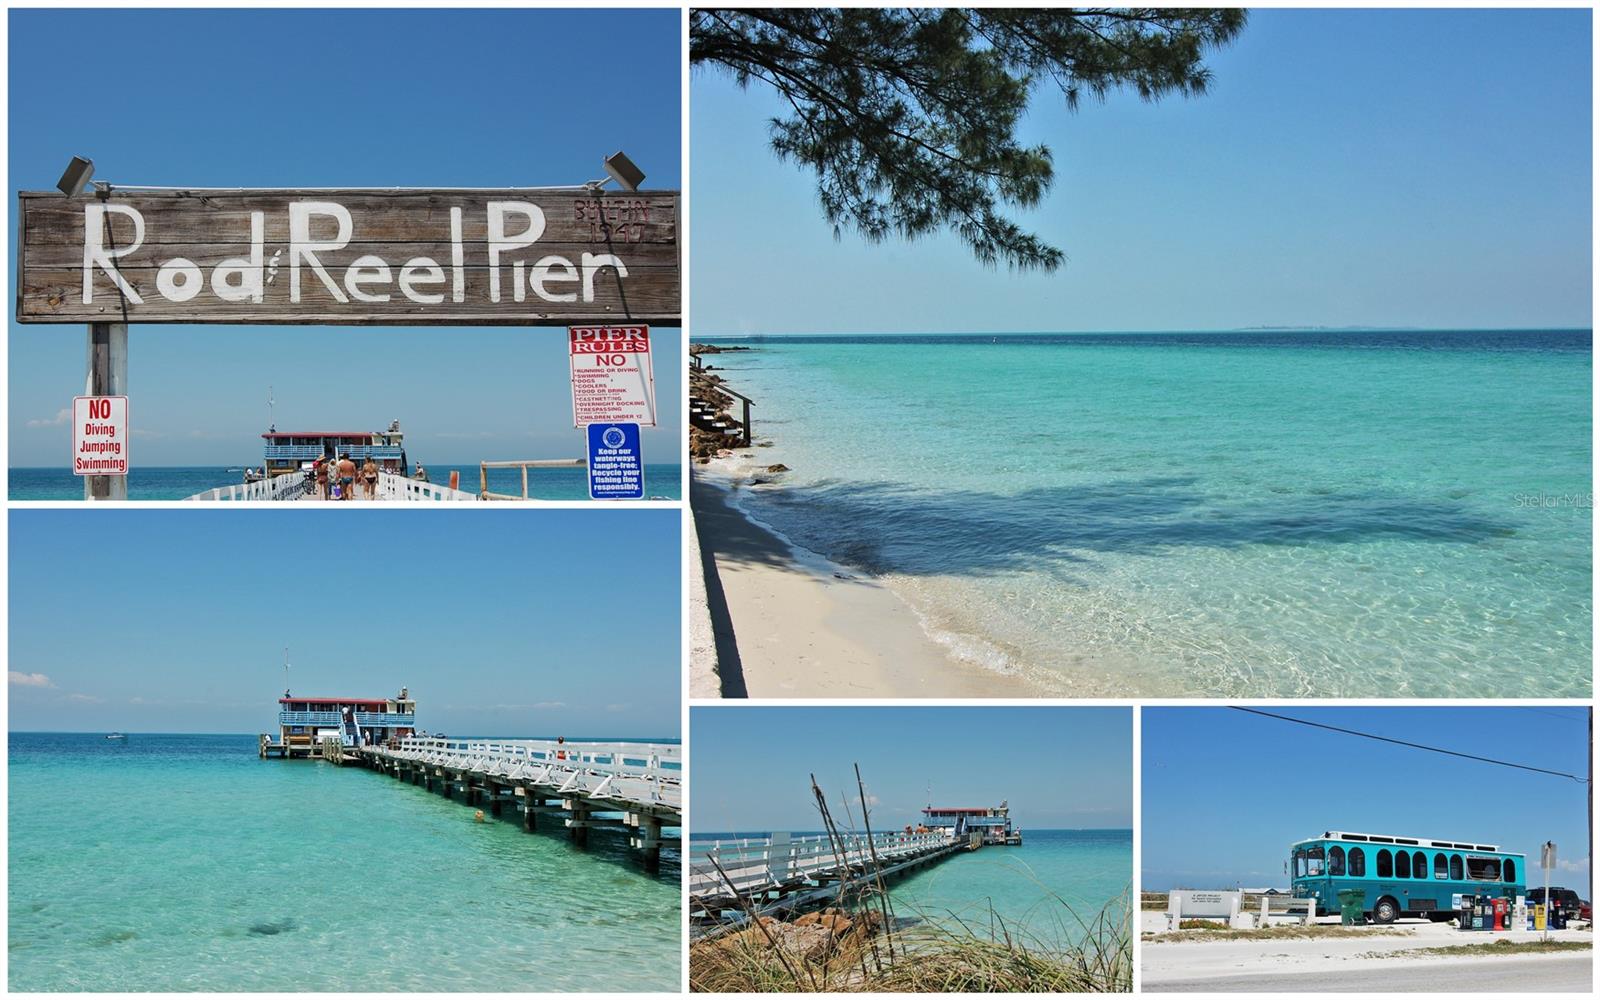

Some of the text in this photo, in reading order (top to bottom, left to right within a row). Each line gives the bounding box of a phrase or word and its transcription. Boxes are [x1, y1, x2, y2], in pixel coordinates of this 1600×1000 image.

[82, 202, 264, 304] Rod
[289, 201, 464, 304] Reel
[486, 200, 629, 303] Pier
[573, 328, 646, 342] PIER
[573, 341, 647, 352] RULES
[596, 354, 626, 366] NO
[89, 399, 111, 419] NO
[85, 423, 115, 437] Diving
[80, 440, 121, 454] Jumping
[76, 457, 125, 471] Swimming
